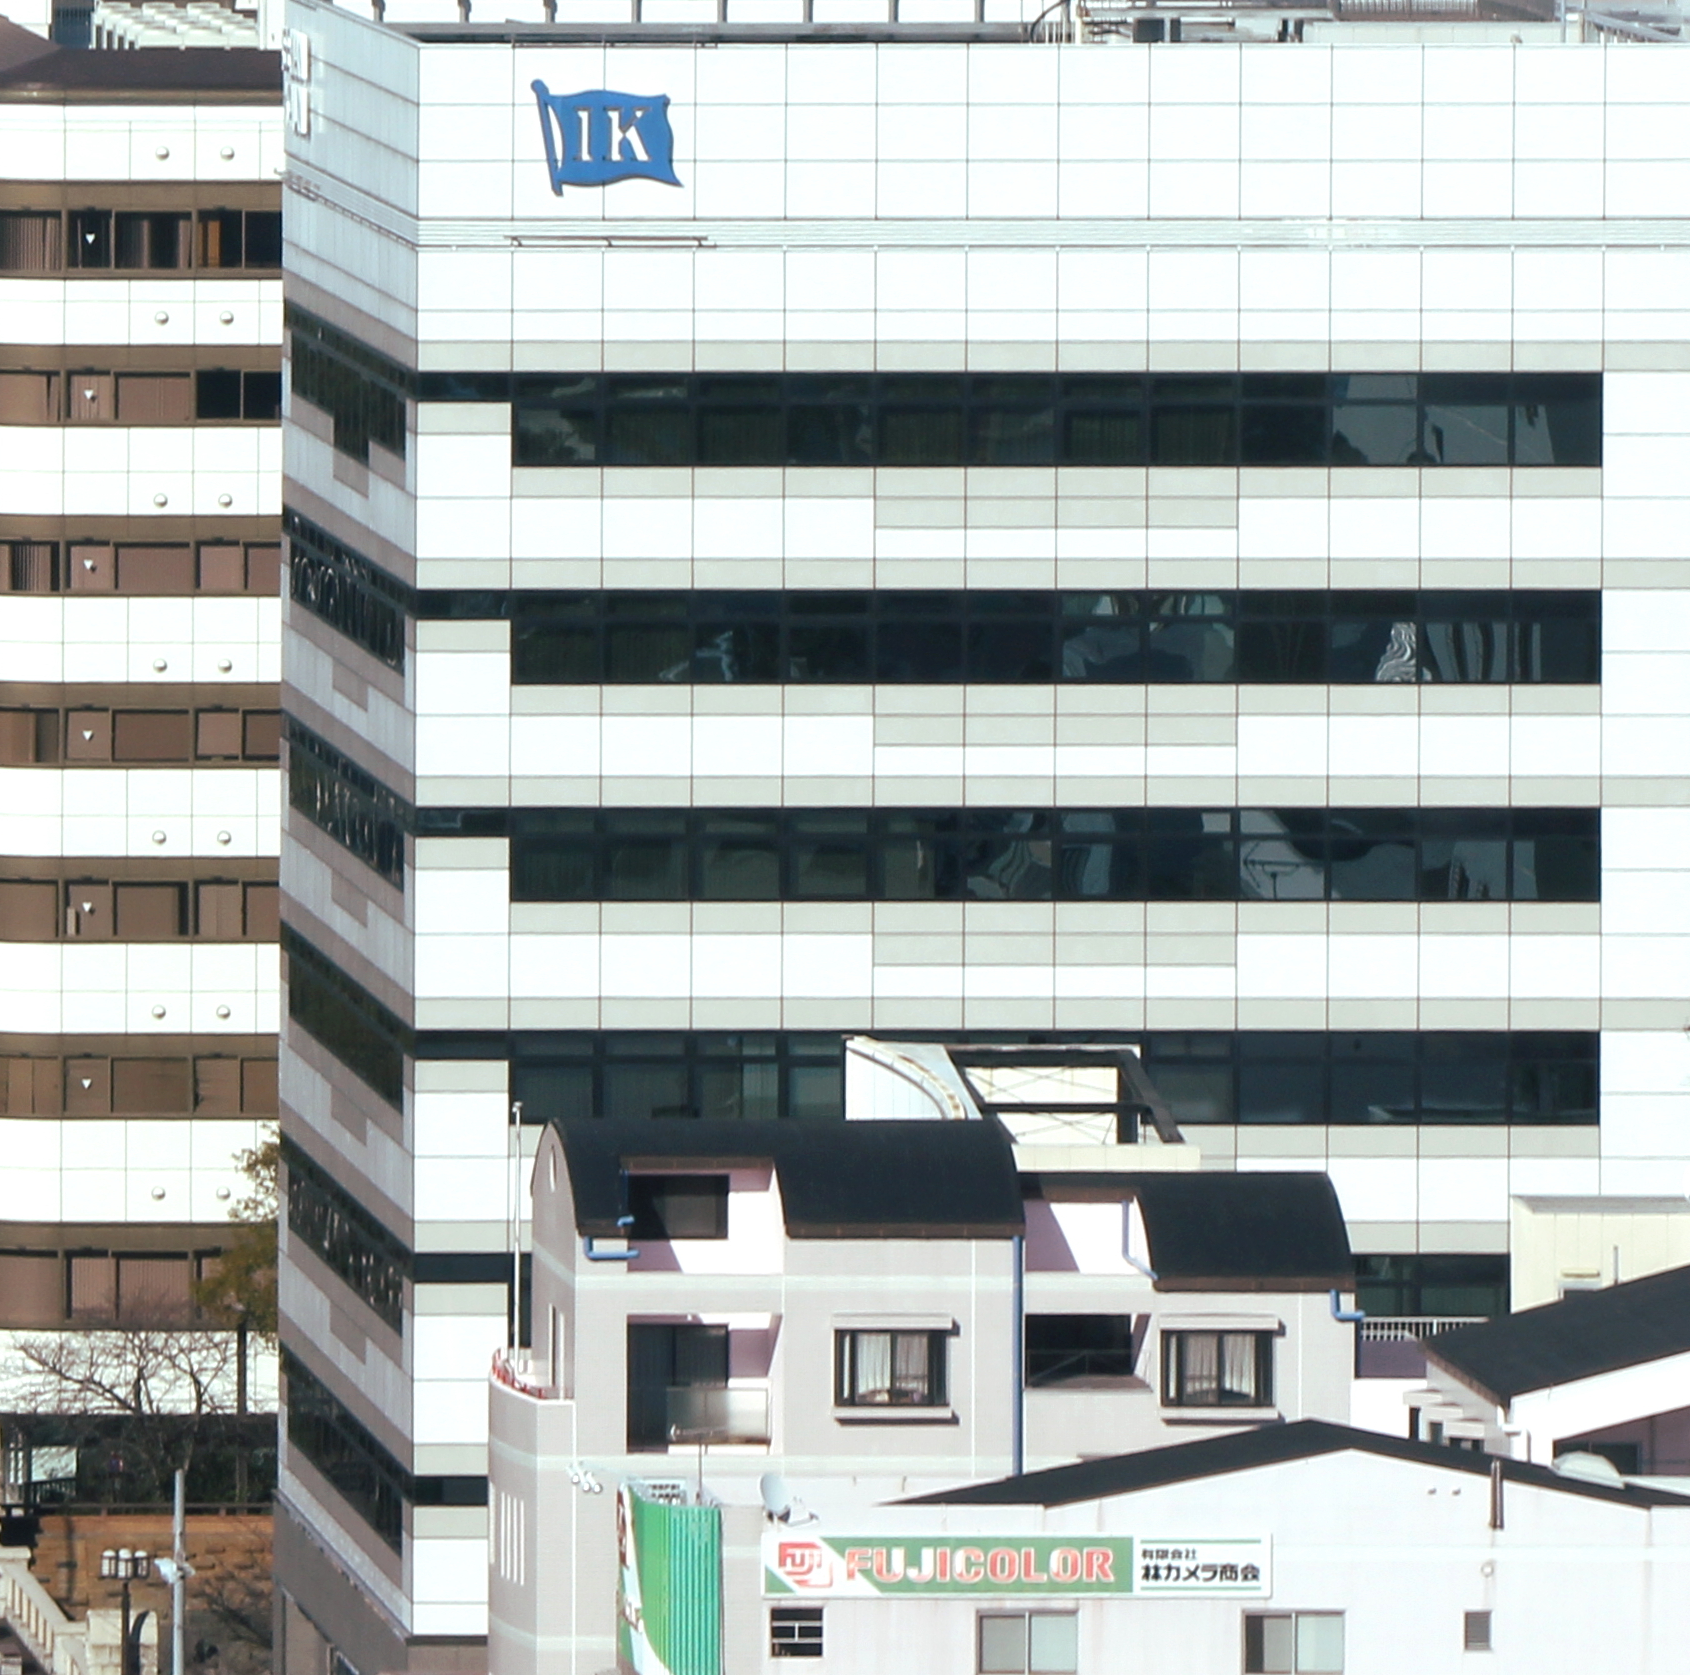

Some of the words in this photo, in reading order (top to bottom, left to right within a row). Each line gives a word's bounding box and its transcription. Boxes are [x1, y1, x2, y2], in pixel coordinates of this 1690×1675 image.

[846, 1546, 1116, 1583] FUJICOLOR
[1141, 1549, 1198, 1561] 有限会社
[1140, 1564, 1260, 1583] 林カメラ商会
